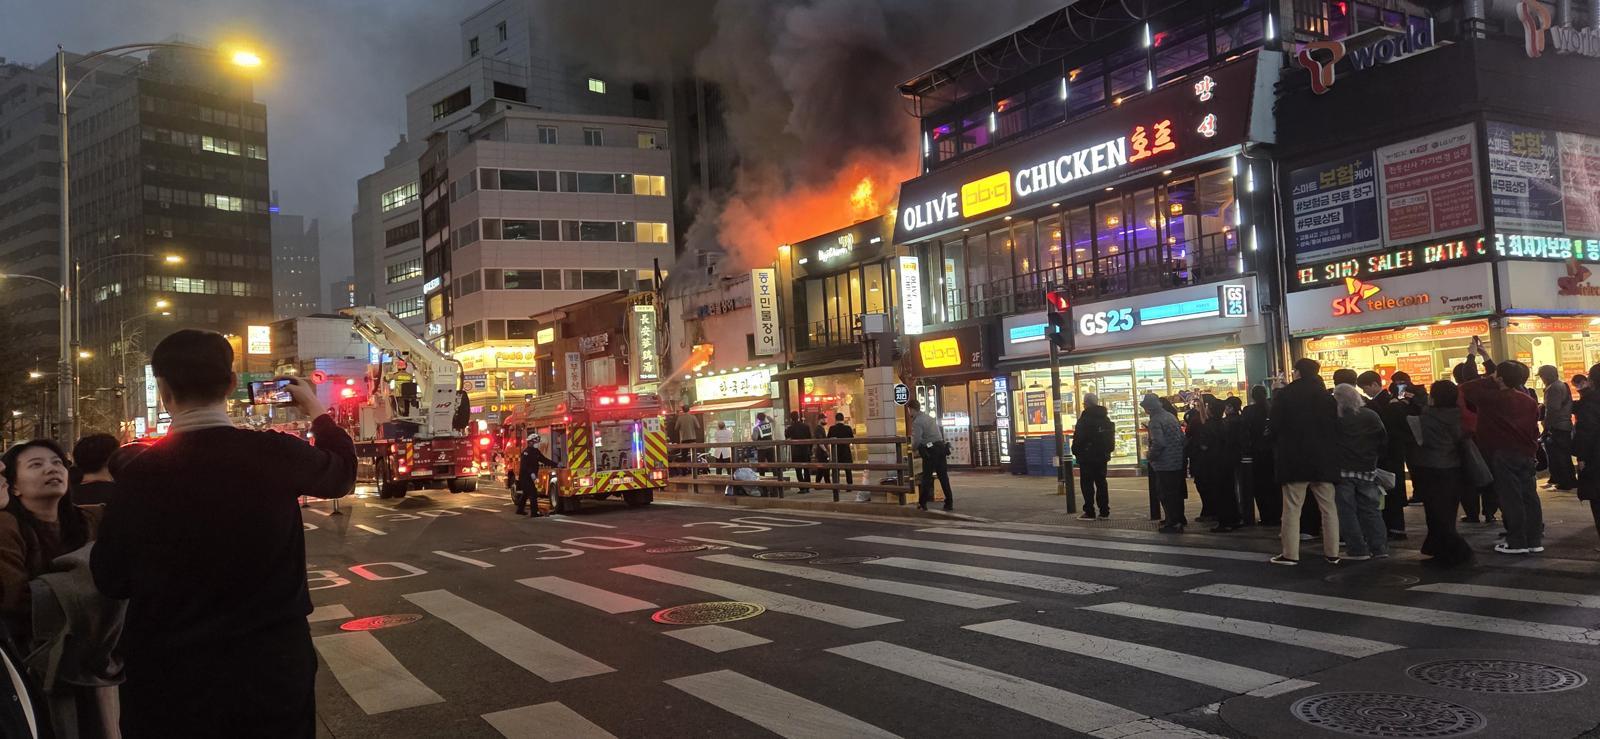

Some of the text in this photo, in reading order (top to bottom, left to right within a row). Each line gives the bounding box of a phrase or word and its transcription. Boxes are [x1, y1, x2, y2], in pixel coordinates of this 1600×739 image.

[1349, 17, 1435, 70] world
[903, 191, 959, 231] OLIVE
[1015, 136, 1127, 197] CHICKEN
[1293, 181, 1318, 195] 스마트
[1354, 167, 1373, 180] 케어
[1493, 179, 1527, 194] #무료상담
[1331, 191, 1351, 204] 무료
[1352, 185, 1373, 199] 청구
[1297, 211, 1341, 231] #무료상담
[1368, 250, 1413, 273] SALE!
[1424, 240, 1469, 264] DATA
[1227, 287, 1242, 301] GS
[1332, 293, 1430, 317] SK telecom
[1229, 301, 1243, 314] 25
[1079, 307, 1135, 337] GS25
[972, 352, 981, 362] 2F
[683, 516, 823, 534] 30
[499, 536, 646, 560] 30
